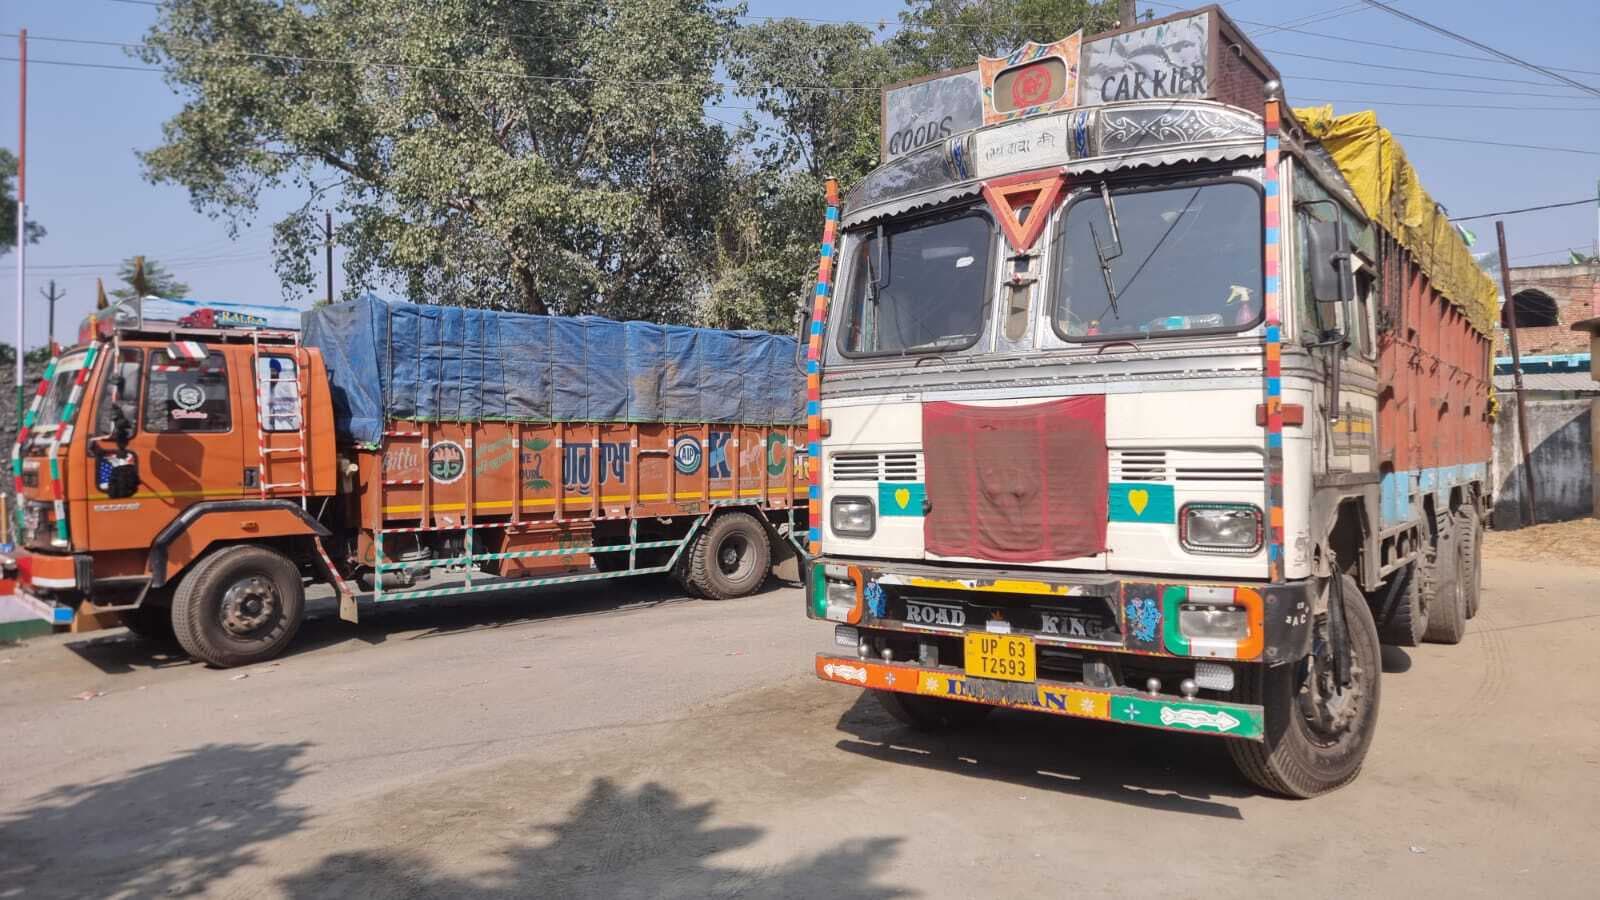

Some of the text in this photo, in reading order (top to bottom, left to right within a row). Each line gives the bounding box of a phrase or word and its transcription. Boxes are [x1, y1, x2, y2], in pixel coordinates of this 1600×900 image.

[889, 115, 953, 155] GOODS
[906, 604, 966, 627] ROAD
[1041, 614, 1101, 638] KING
[981, 639, 1026, 658] UP 63
[981, 656, 1026, 676] T2593
